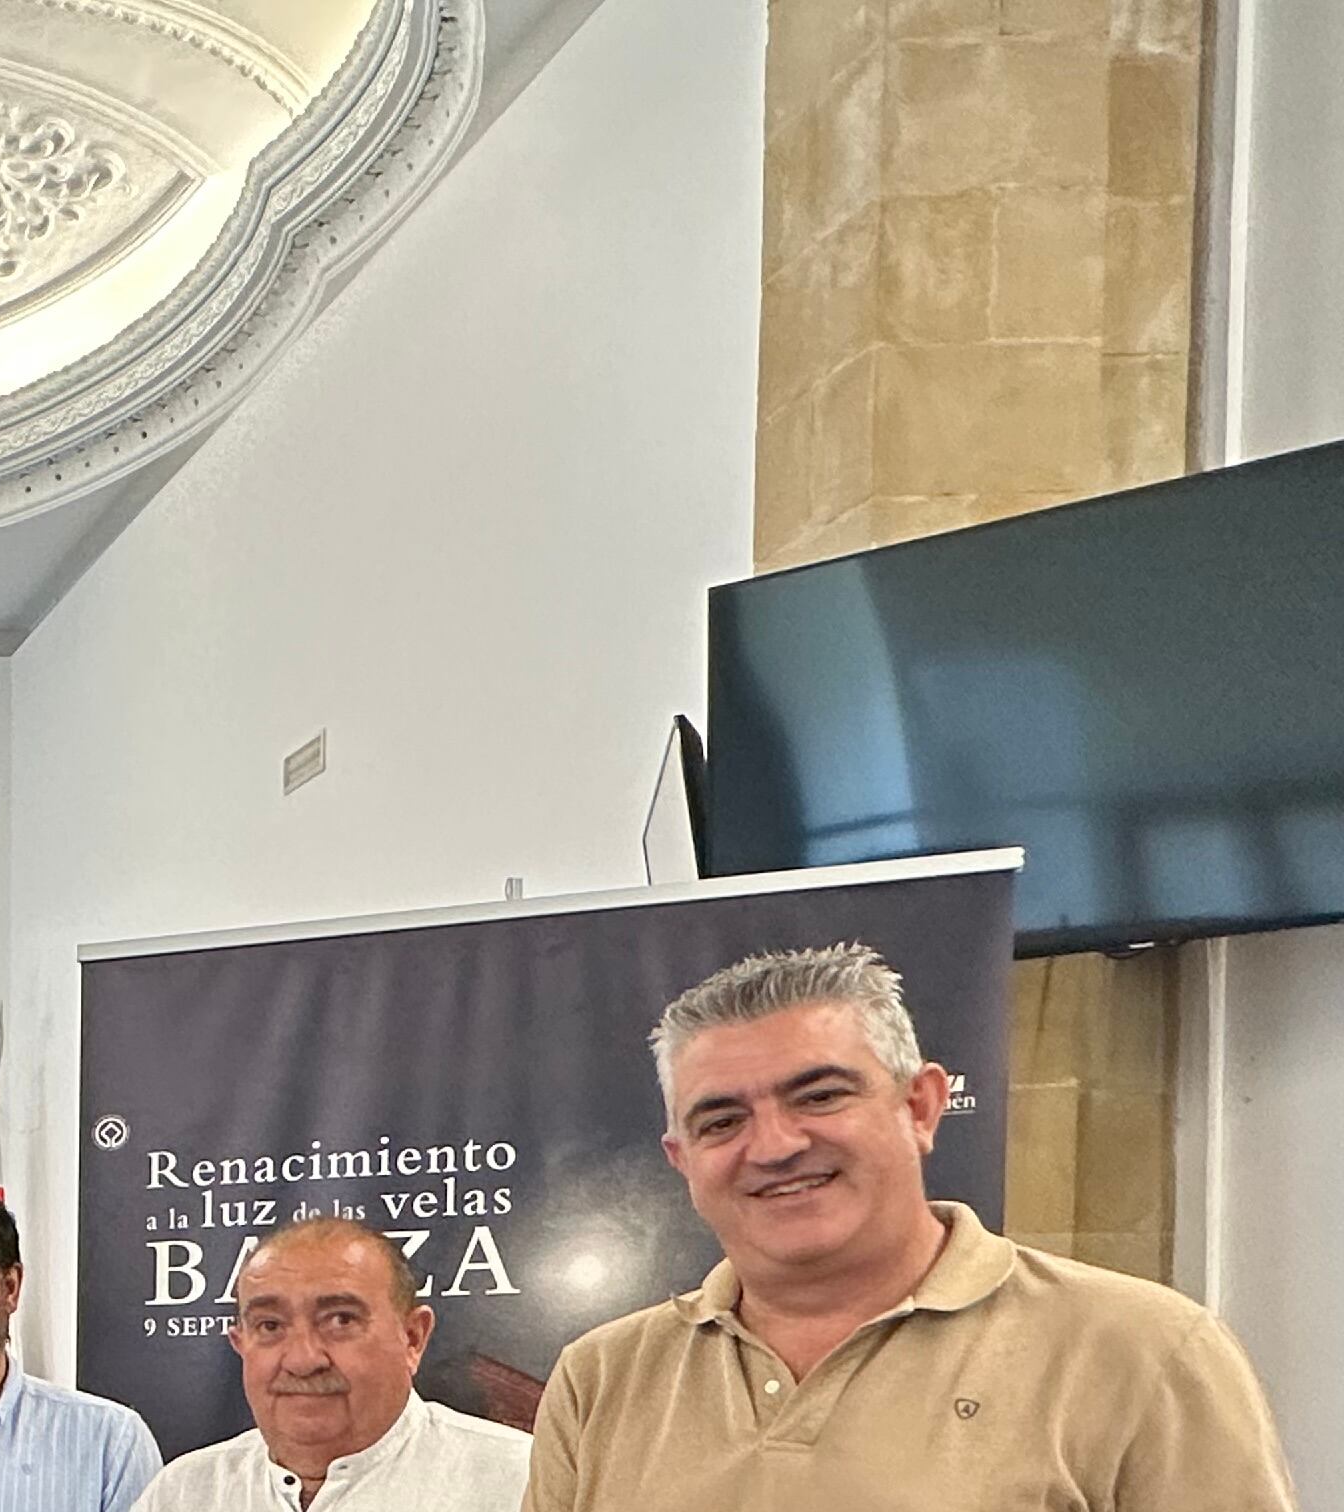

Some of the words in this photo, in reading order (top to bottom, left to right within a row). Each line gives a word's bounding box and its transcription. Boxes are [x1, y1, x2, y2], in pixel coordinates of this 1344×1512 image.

[146, 1136, 516, 1190] Renacimiento
[146, 1214, 158, 1231] a
[168, 1208, 189, 1229] la
[201, 1190, 277, 1228] luz
[333, 1200, 366, 1221] las
[380, 1177, 513, 1220] velas
[144, 1319, 157, 1337] 9
